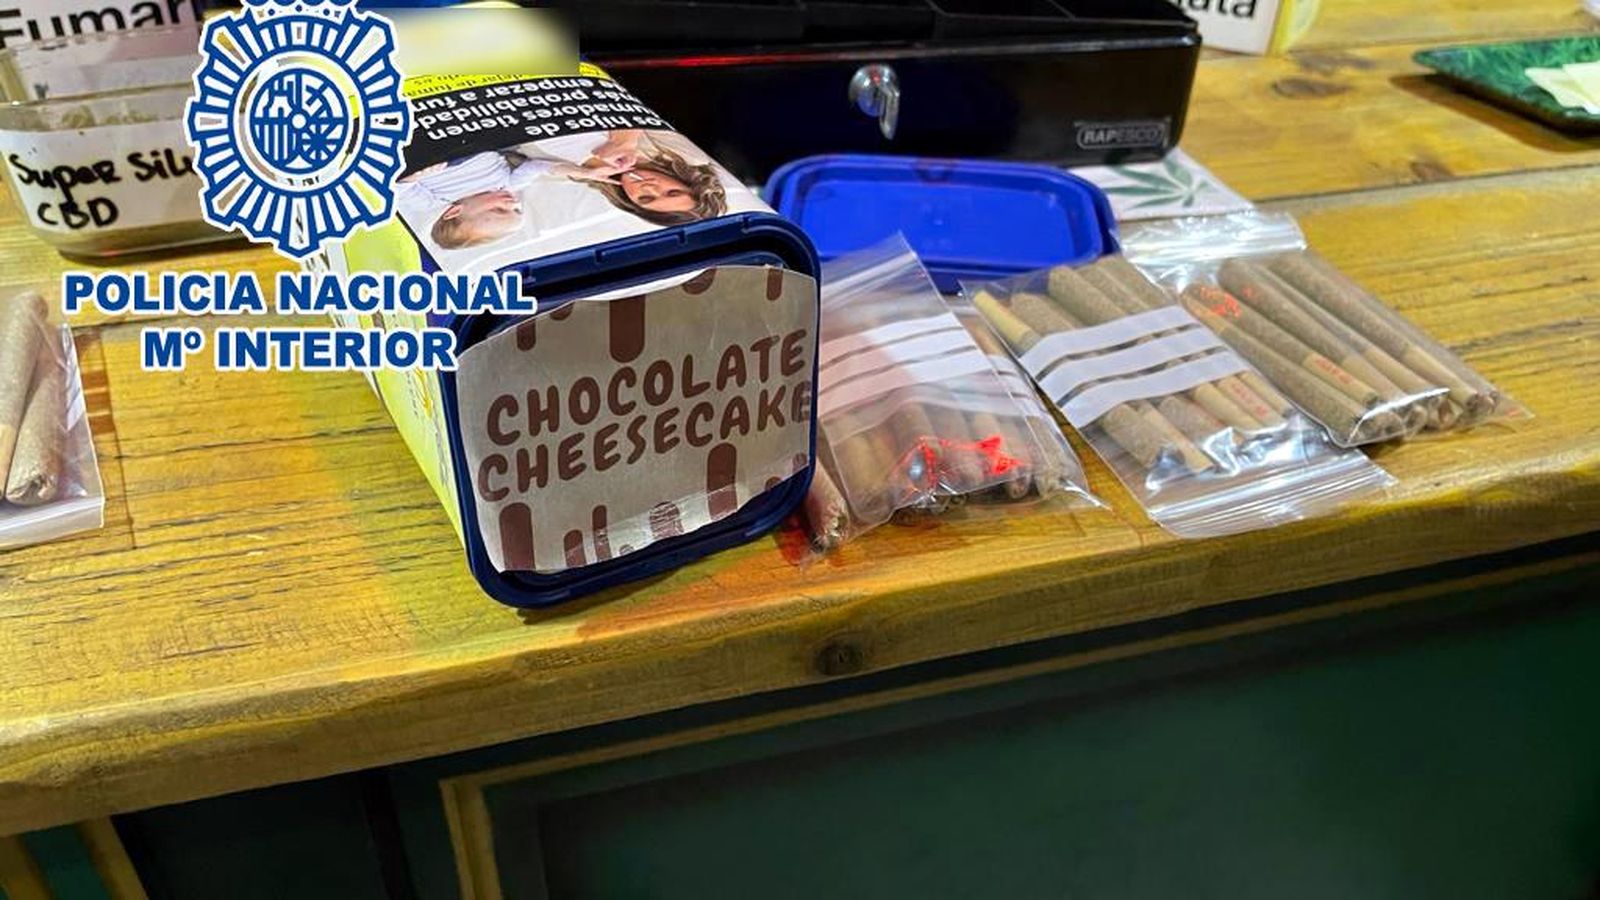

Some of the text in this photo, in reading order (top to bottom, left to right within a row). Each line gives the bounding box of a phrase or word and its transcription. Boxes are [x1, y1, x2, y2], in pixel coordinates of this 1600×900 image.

[460, 91, 478, 102] a
[485, 77, 594, 98] empezar
[413, 88, 590, 130] probabilidad
[564, 114, 633, 129] hijos
[427, 114, 520, 140] tienen
[524, 122, 561, 137] de
[37, 197, 119, 229] CBD
[487, 329, 807, 446] CHOCOLATE
[478, 380, 813, 501] CHEESECAKE
